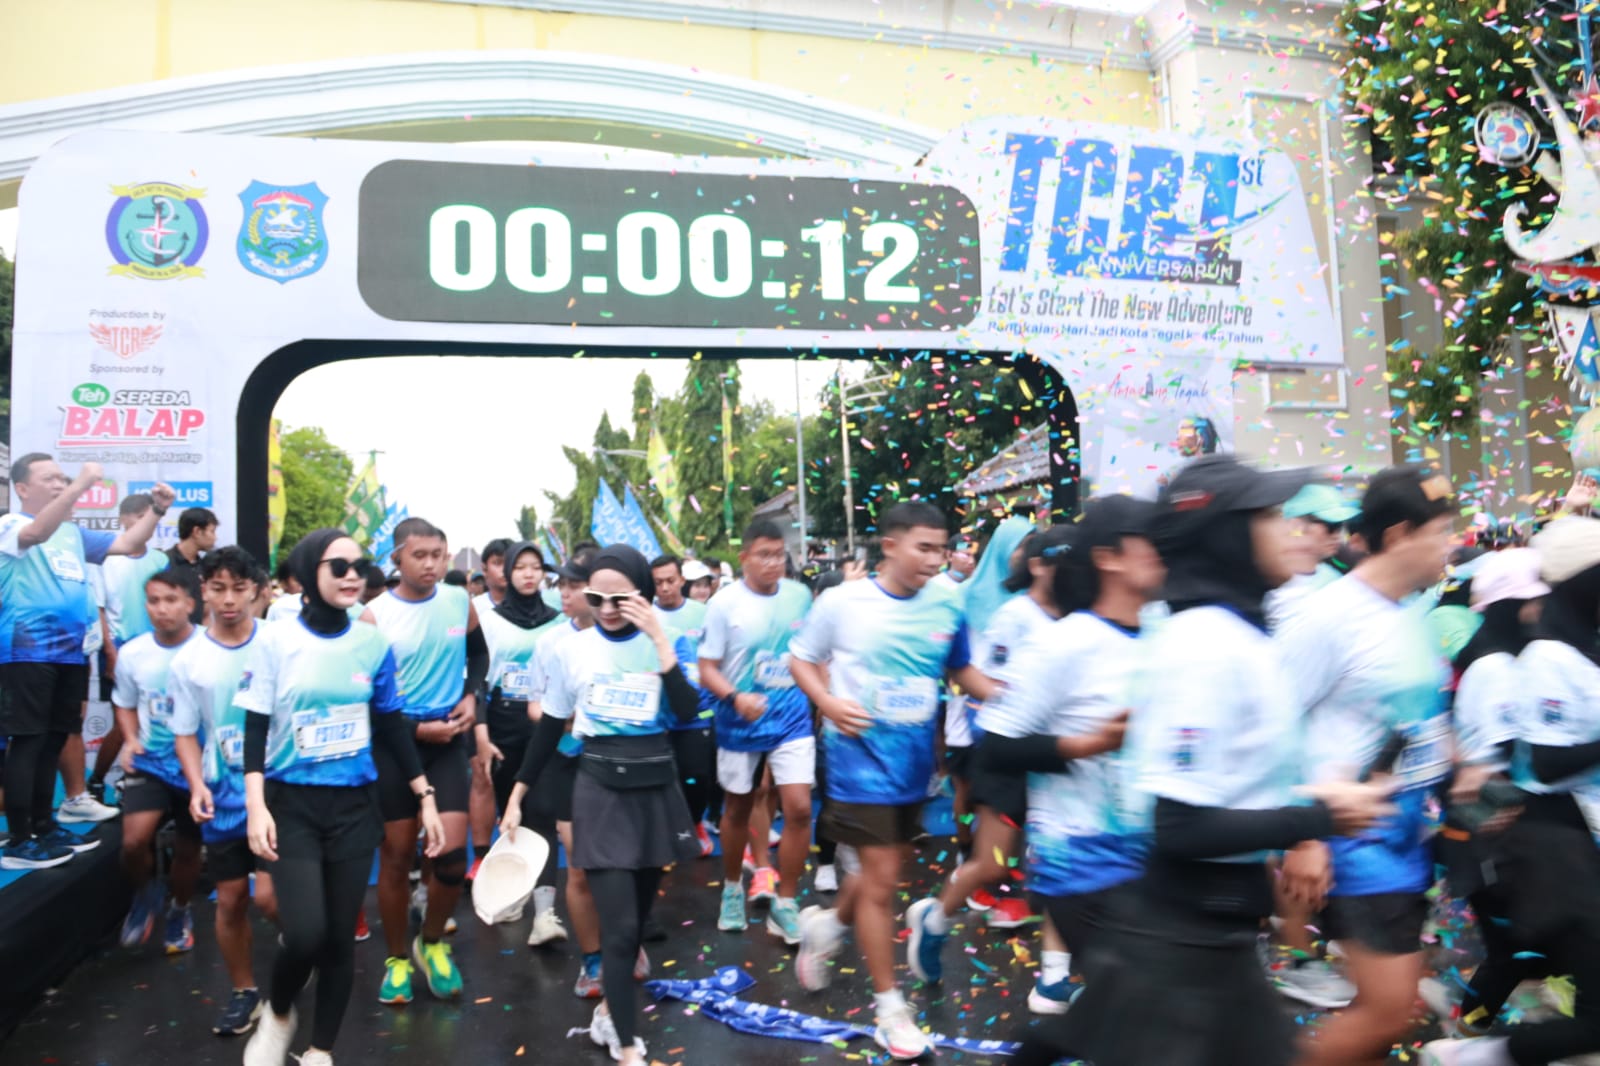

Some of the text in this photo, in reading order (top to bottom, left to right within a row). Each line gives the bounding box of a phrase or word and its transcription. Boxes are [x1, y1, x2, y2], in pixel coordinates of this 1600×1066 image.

[429, 204, 921, 302] 00:00:12
[89, 309, 166, 321] Production by
[988, 285, 1254, 327] Let's Start The New Adventure
[111, 326, 142, 356] TCR
[1120, 327, 1148, 339] Kota
[89, 364, 164, 376] Sponsored by
[78, 387, 191, 405] Teh SEPEDA
[63, 406, 205, 437] BALAP
